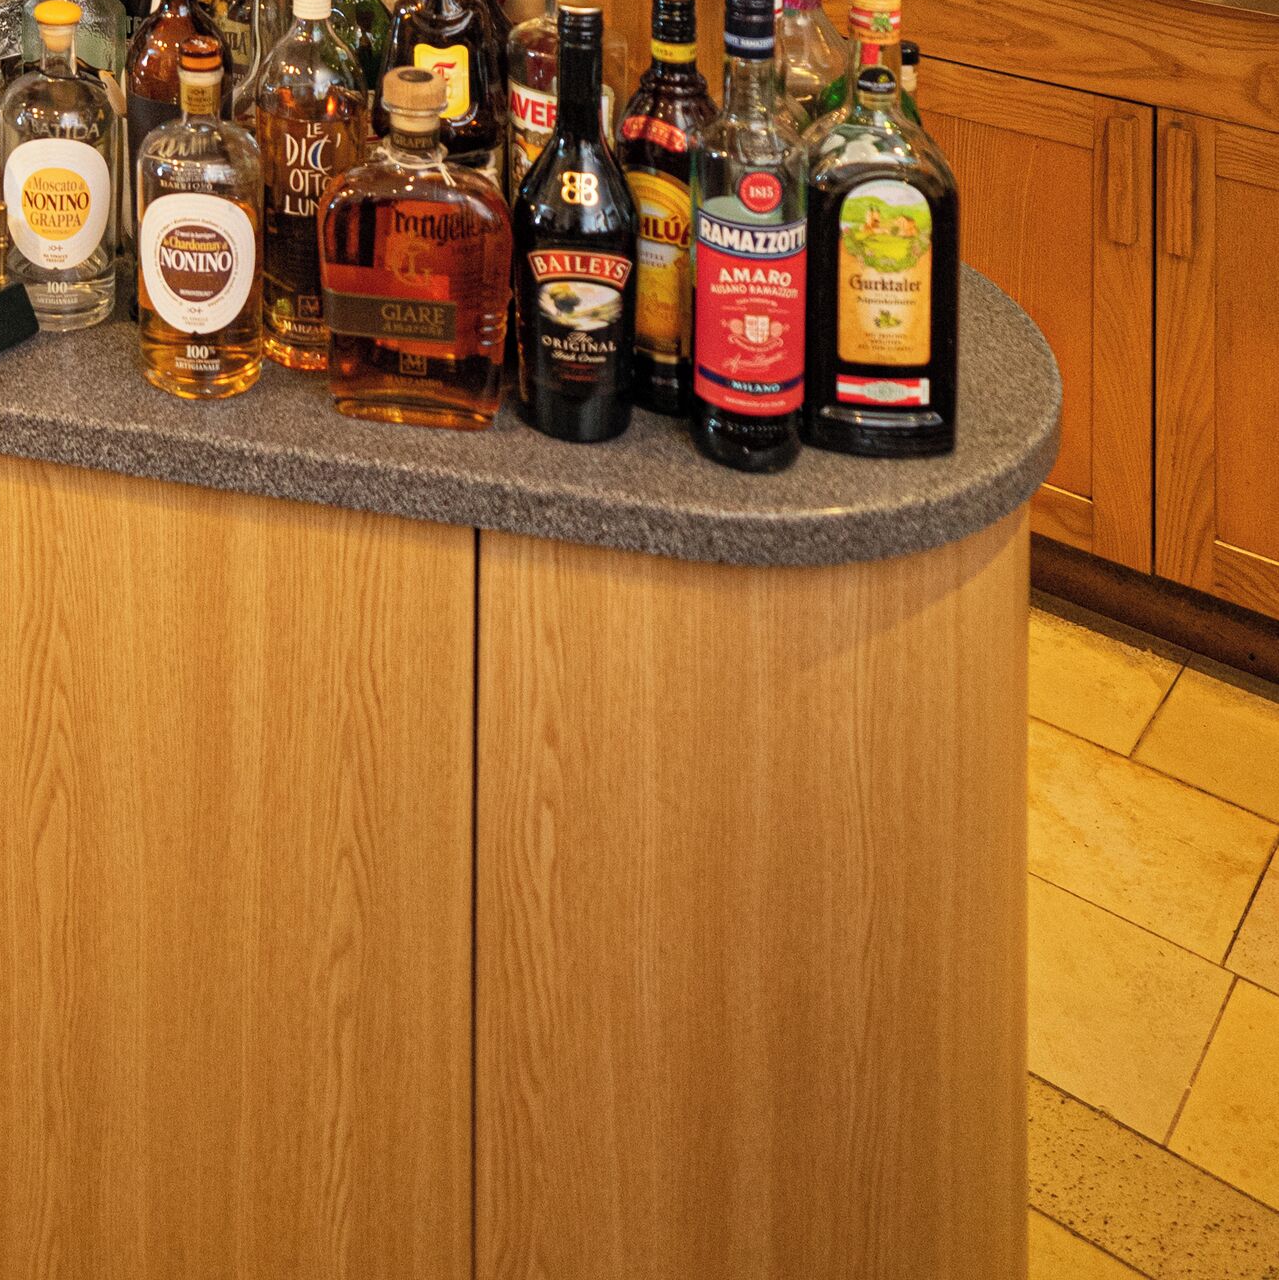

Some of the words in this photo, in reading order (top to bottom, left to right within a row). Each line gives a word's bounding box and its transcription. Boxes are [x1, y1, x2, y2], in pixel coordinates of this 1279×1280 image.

[306, 122, 324, 138] LE
[33, 176, 77, 191] Moscato
[23, 190, 90, 211] NONINO
[748, 186, 775, 199] 1815
[30, 212, 82, 228] GRAPPA
[700, 215, 807, 254] RAMAZZOTTI
[171, 237, 222, 253] Chardonnay
[160, 248, 233, 273] NONINO
[534, 253, 628, 281] BAILEYS
[720, 267, 792, 286] AMARO
[849, 273, 923, 293] Gurktaler
[748, 284, 799, 299] RAMAZZOTTI
[381, 303, 446, 320] GIARE
[541, 336, 618, 353] ORIGINAL
[730, 380, 780, 392] MILANO
